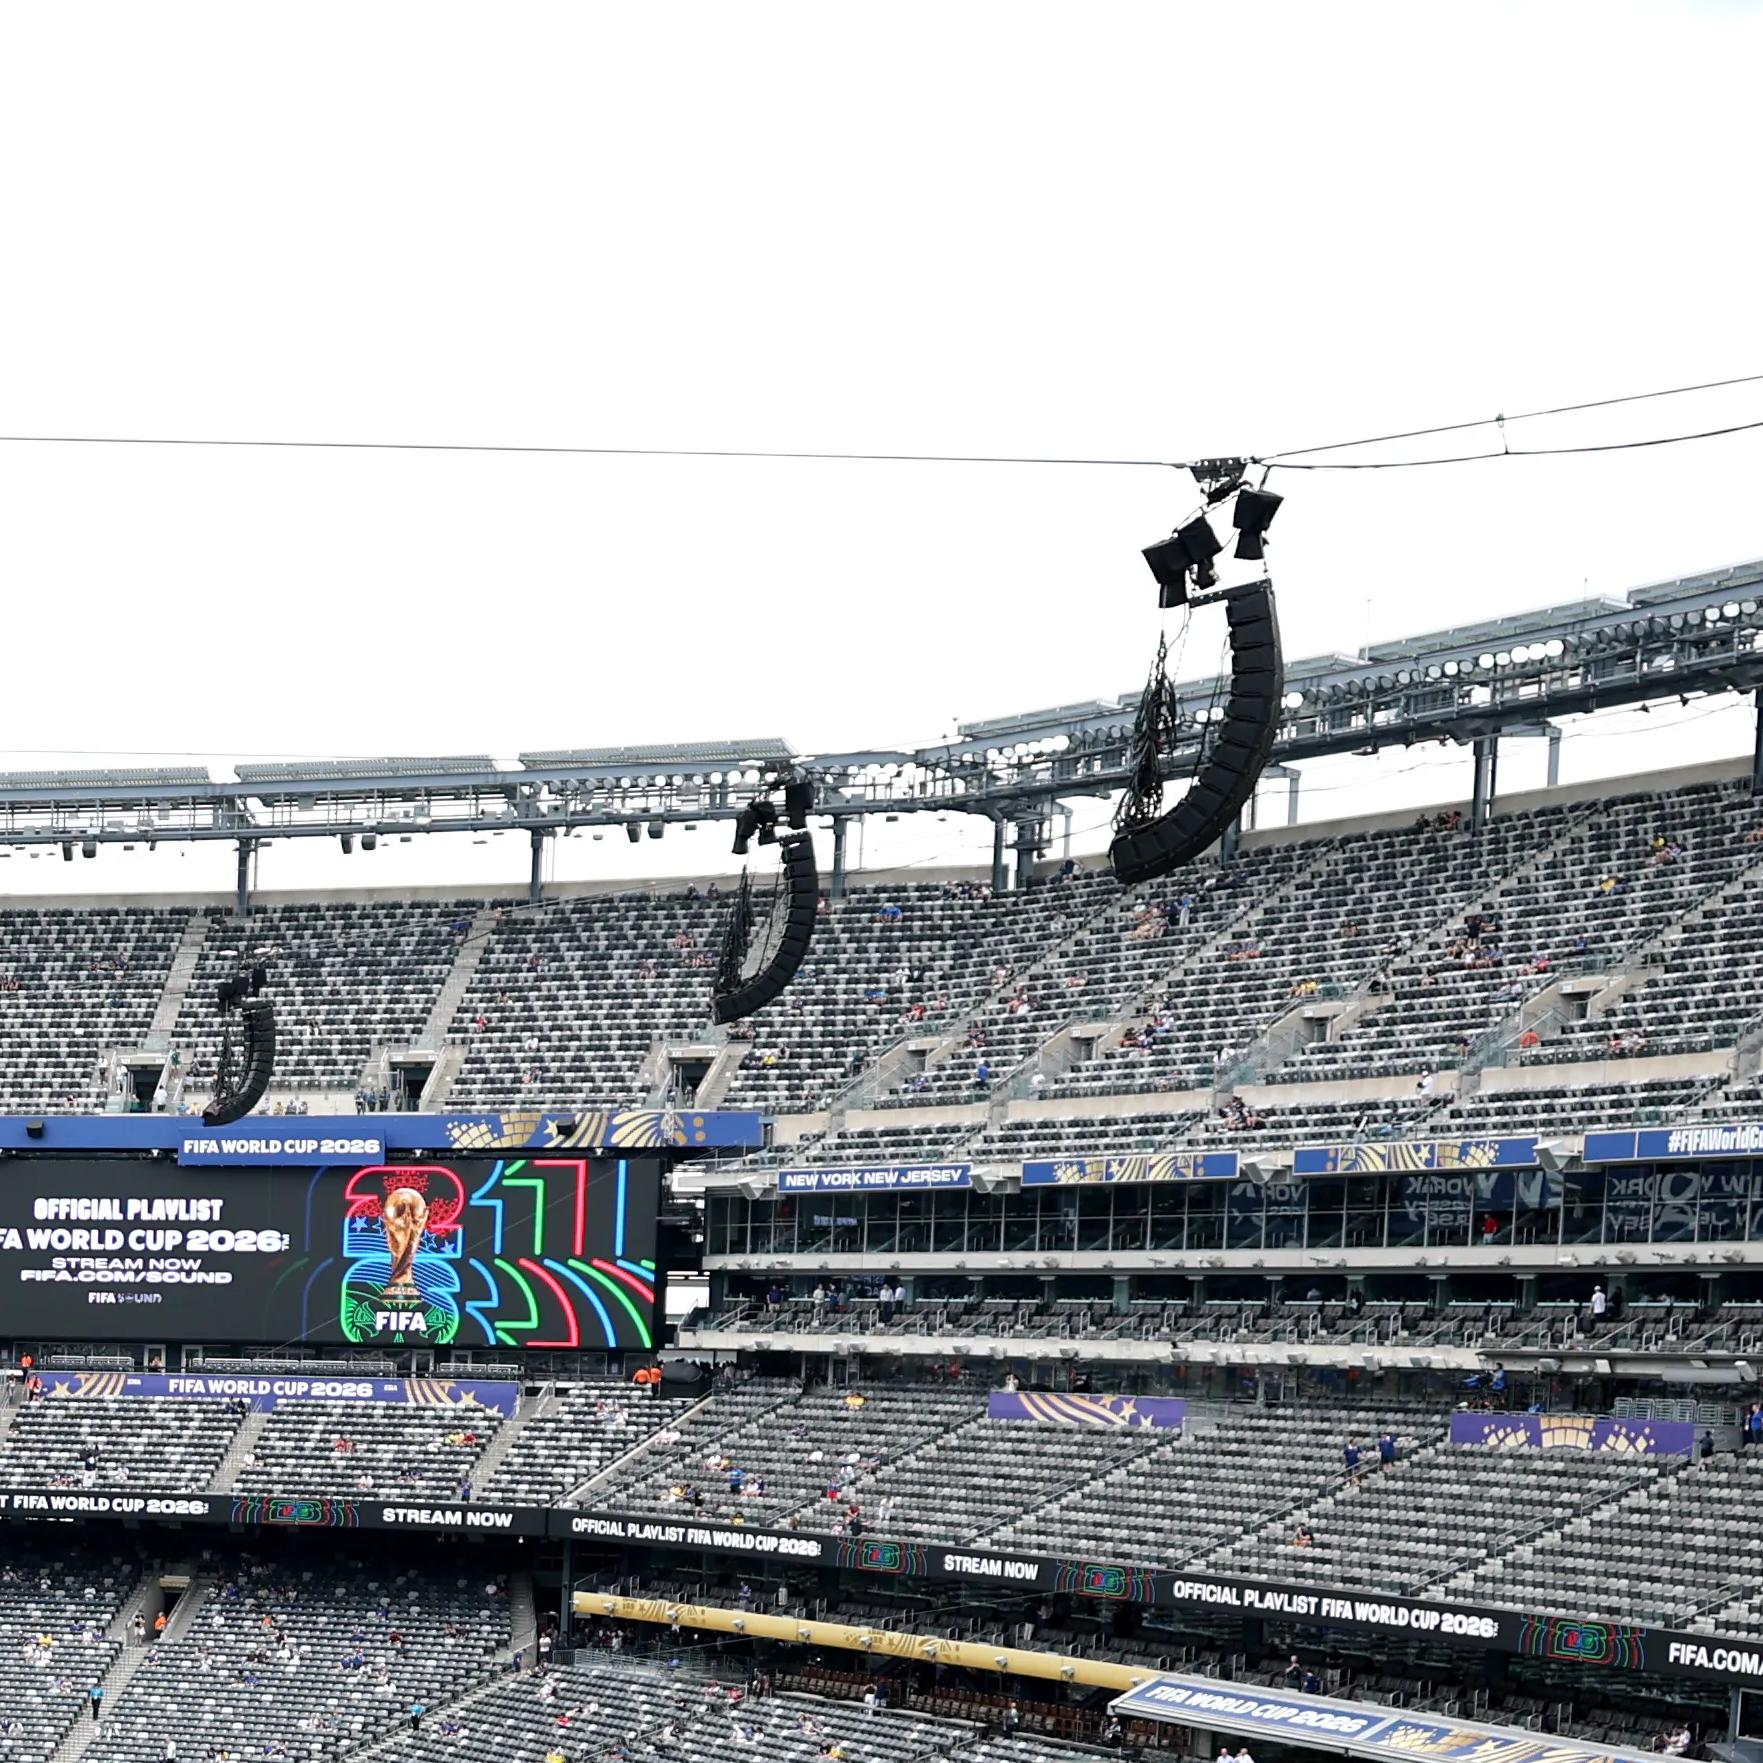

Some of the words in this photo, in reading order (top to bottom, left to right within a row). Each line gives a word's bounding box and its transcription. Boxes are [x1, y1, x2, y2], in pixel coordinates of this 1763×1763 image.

[184, 1140, 220, 1153] FIFA
[221, 1140, 282, 1153] WORLD
[284, 1140, 318, 1153] CUP
[320, 1140, 380, 1153] 2026
[786, 1174, 819, 1186] NEW
[822, 1173, 861, 1185] YORK
[864, 1172, 898, 1184] NEW
[901, 1170, 963, 1183] JERSEY
[33, 1198, 125, 1220] OFFICIAL
[128, 1199, 223, 1221] PLAYLIST
[26, 1228, 127, 1251] WORLD
[130, 1229, 183, 1251] CUP
[51, 1258, 144, 1270] STREAM
[149, 1258, 201, 1270] NOW
[20, 1270, 232, 1283] FIFA.COM/SOUND
[376, 1311, 427, 1331] FIFA
[169, 1380, 207, 1394] FIFA
[208, 1380, 271, 1395] WORLD
[273, 1381, 308, 1395] CUP
[310, 1381, 373, 1396] 2026
[13, 1494, 47, 1511] FIFA
[49, 1495, 110, 1512] WORLD
[111, 1497, 144, 1513] CUP
[382, 1508, 462, 1525] STREAM
[466, 1511, 513, 1527] NOW
[943, 1554, 1002, 1577] STREAM
[1005, 1560, 1039, 1580] NOW
[1173, 1580, 1241, 1607] OFFICIAL
[1244, 1588, 1319, 1617] PLAYLIST
[1322, 1597, 1353, 1621] FIFA
[1353, 1601, 1408, 1628] WORLD
[1409, 1608, 1439, 1632] CUP
[1145, 1686, 1193, 1708] FIFA
[1193, 1692, 1258, 1717] WORLD
[1251, 1698, 1300, 1723] CUP
[1287, 1702, 1369, 1732] 2026
